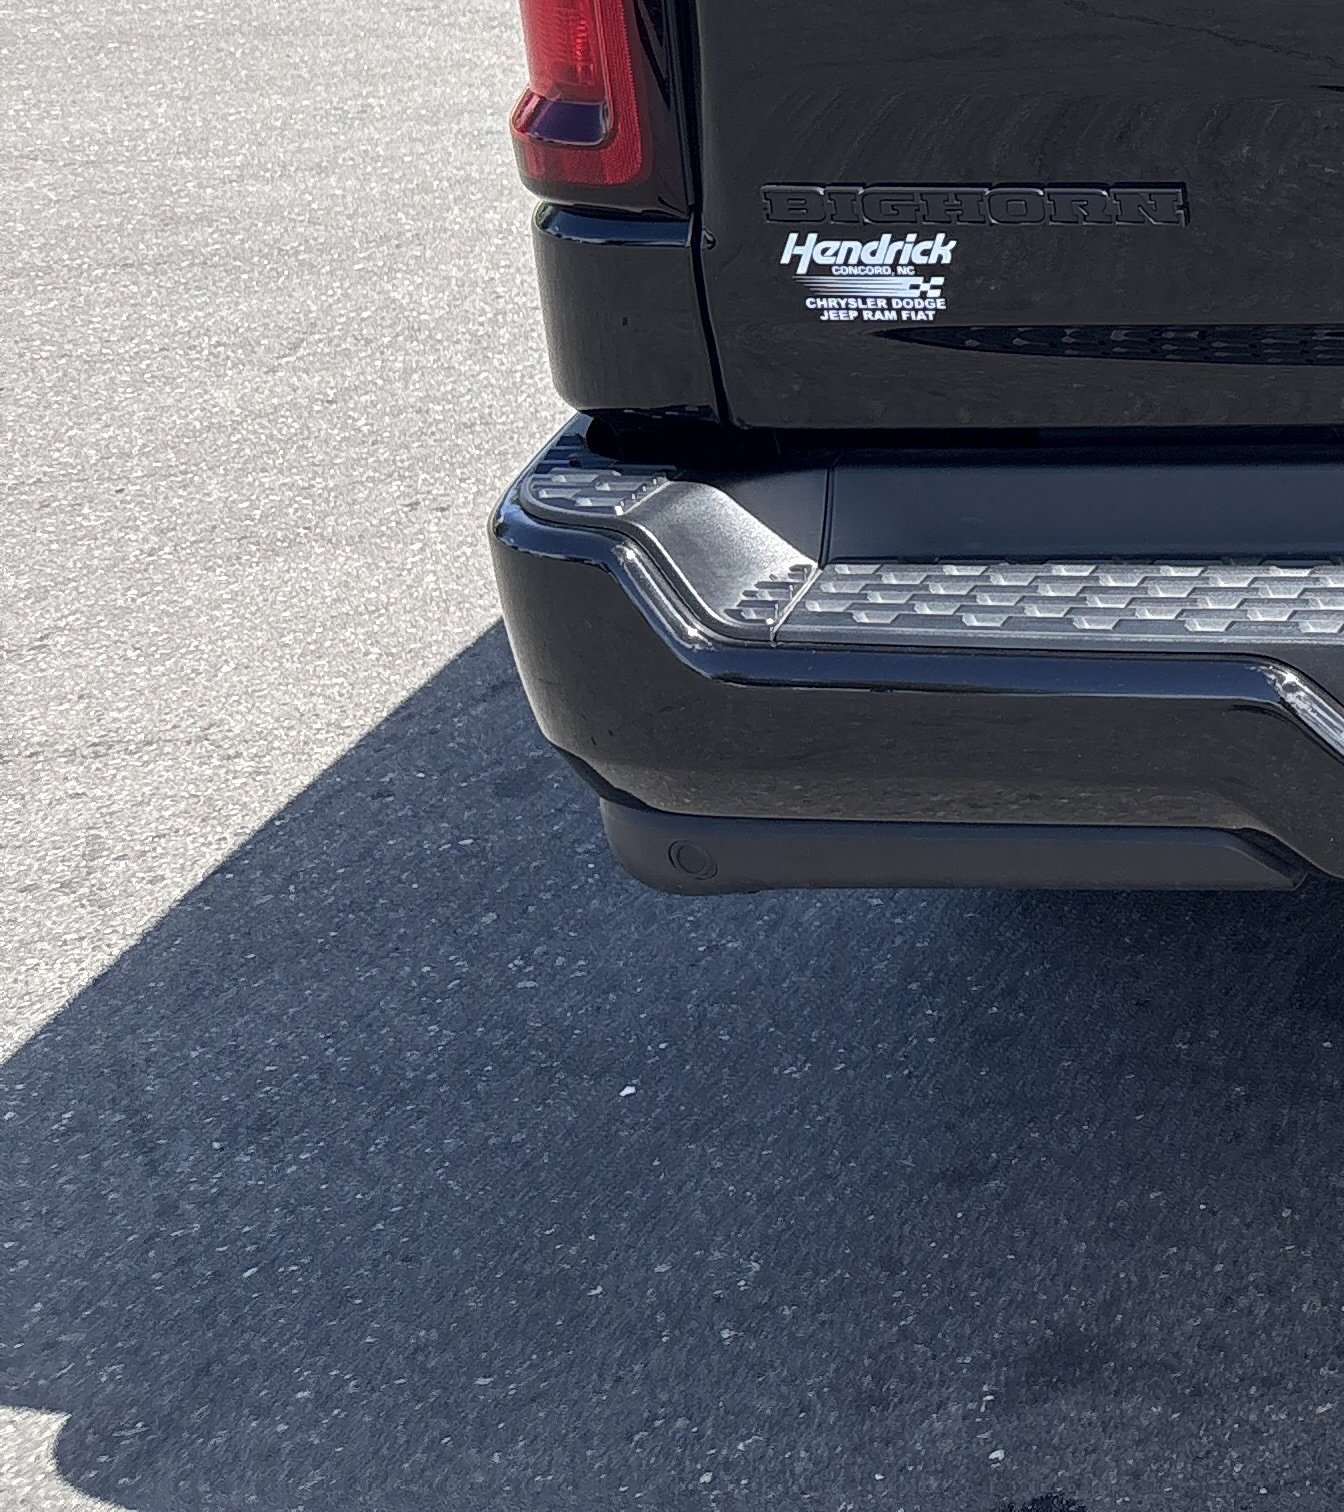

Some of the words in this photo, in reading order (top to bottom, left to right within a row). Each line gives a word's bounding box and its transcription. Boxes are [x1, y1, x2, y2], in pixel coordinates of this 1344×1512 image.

[780, 232, 957, 275] Hendrick
[831, 265, 895, 277] CONCORD,
[897, 265, 916, 276] NC
[805, 297, 888, 309] CHRYSLER
[892, 298, 947, 310] DODGE
[819, 310, 858, 321] JEEP
[862, 310, 898, 321] RAM
[901, 310, 936, 321] FIAT
